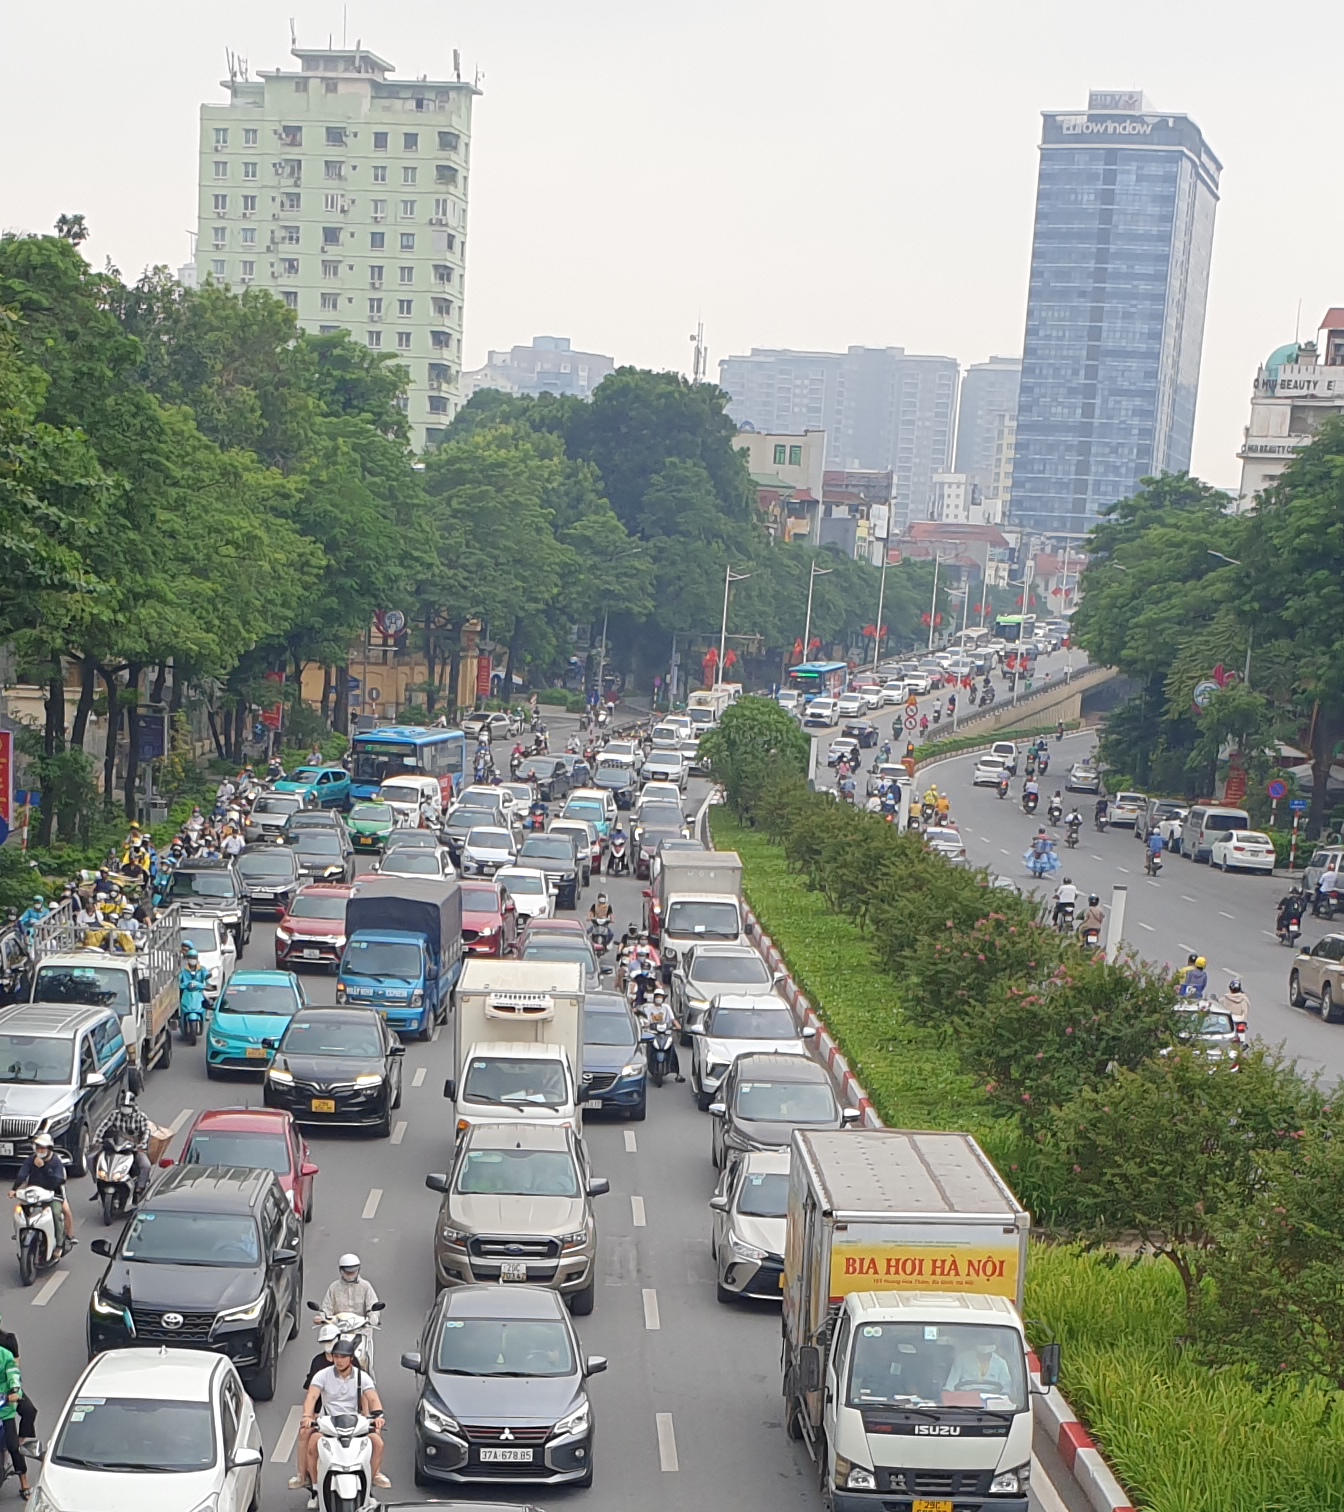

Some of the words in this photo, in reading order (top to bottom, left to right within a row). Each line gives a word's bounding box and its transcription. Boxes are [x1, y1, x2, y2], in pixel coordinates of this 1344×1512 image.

[1063, 119, 1153, 135] Eurowindow
[1280, 379, 1318, 390] BEAUTY
[844, 1257, 879, 1275] BIA
[884, 1257, 925, 1276] HƠI
[930, 1253, 960, 1277] HÀ
[966, 1255, 1005, 1282] NỘI
[914, 1425, 960, 1436] ISUZU
